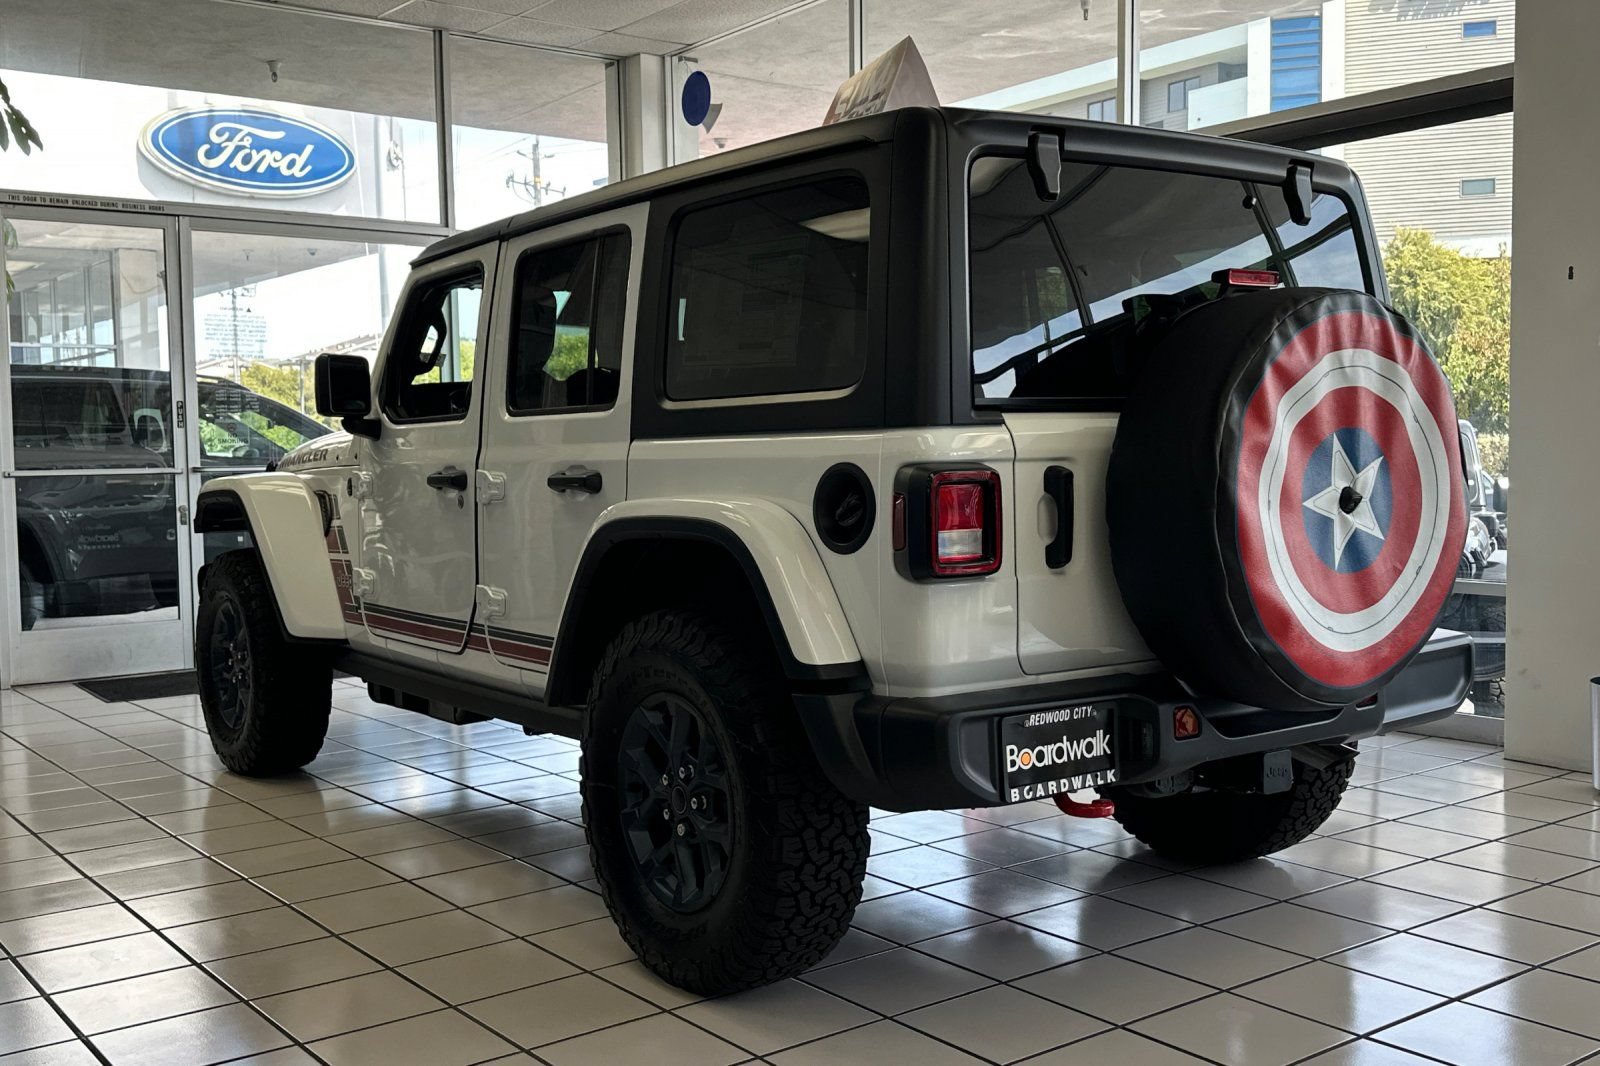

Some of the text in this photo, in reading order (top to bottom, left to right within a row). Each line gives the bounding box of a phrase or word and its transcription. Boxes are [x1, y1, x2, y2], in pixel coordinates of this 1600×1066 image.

[197, 122, 315, 178] Ford
[49, 197, 69, 205] REMAIN
[71, 199, 97, 207] UNLOCKED
[100, 201, 119, 209] DURING
[121, 203, 145, 211] BUSINESS
[1029, 705, 1093, 727] REDWOOD CITY
[1006, 729, 1111, 772] Boardwalk
[1010, 769, 1116, 802] BOARDWALK
